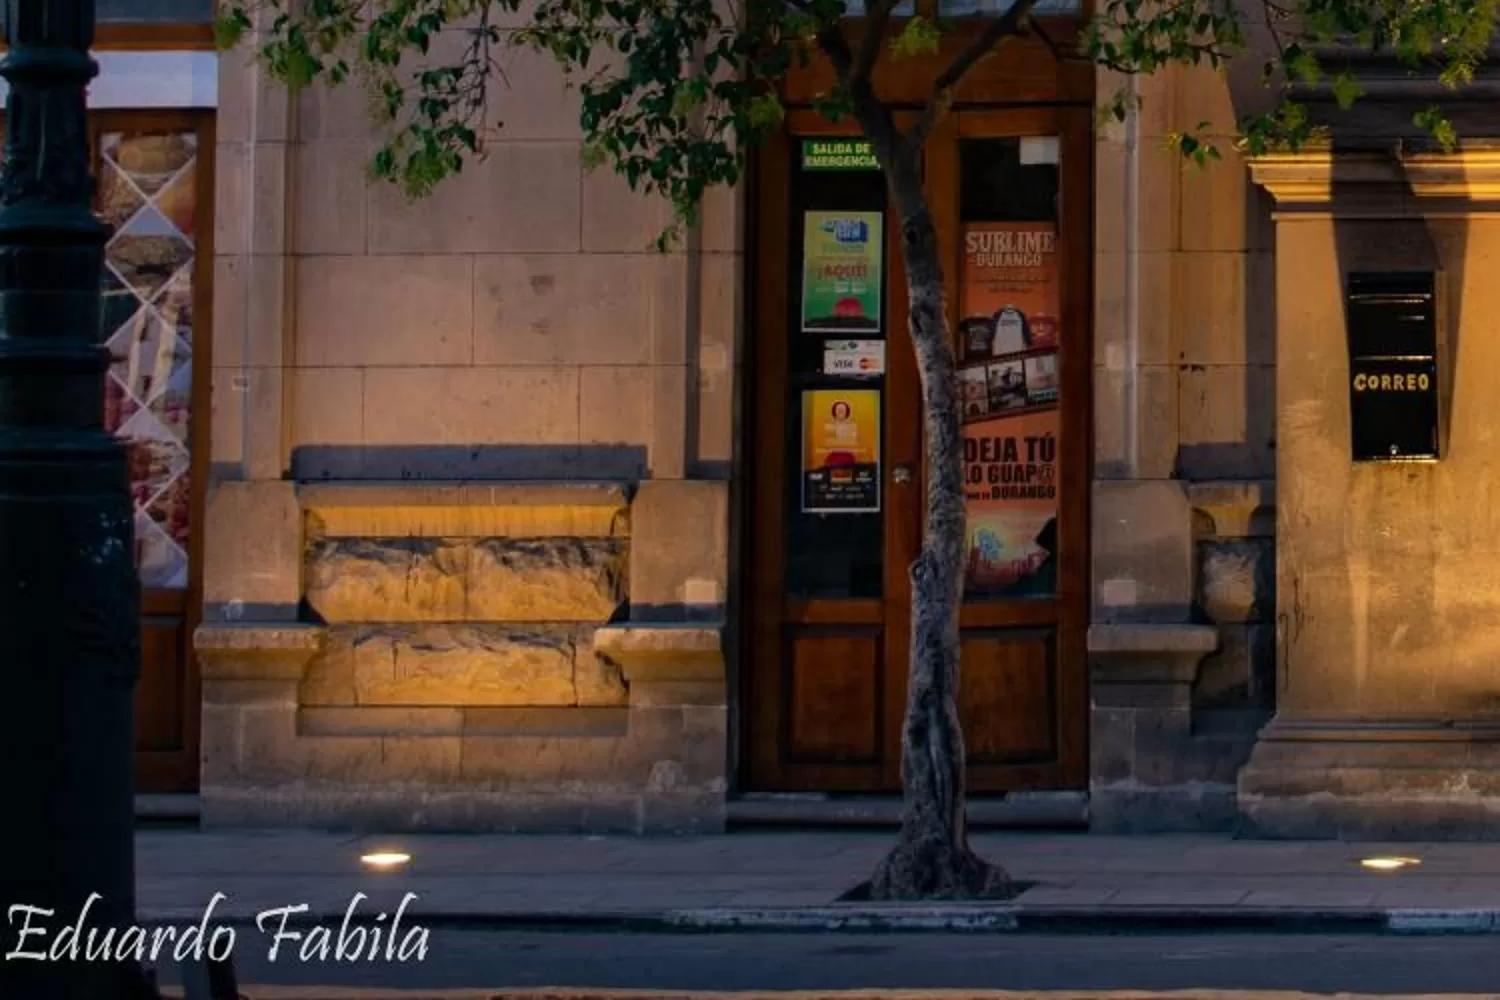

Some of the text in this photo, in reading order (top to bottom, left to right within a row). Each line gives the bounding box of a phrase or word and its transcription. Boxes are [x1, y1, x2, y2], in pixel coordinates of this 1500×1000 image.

[812, 142, 871, 154] SALIDA DE
[804, 155, 878, 167] EMERGENCIA
[965, 230, 1055, 253] SUBLIME
[1353, 373, 1429, 391] CORREO
[964, 431, 1055, 462] DEJA TÚ
[992, 486, 1056, 499] DURANGO
